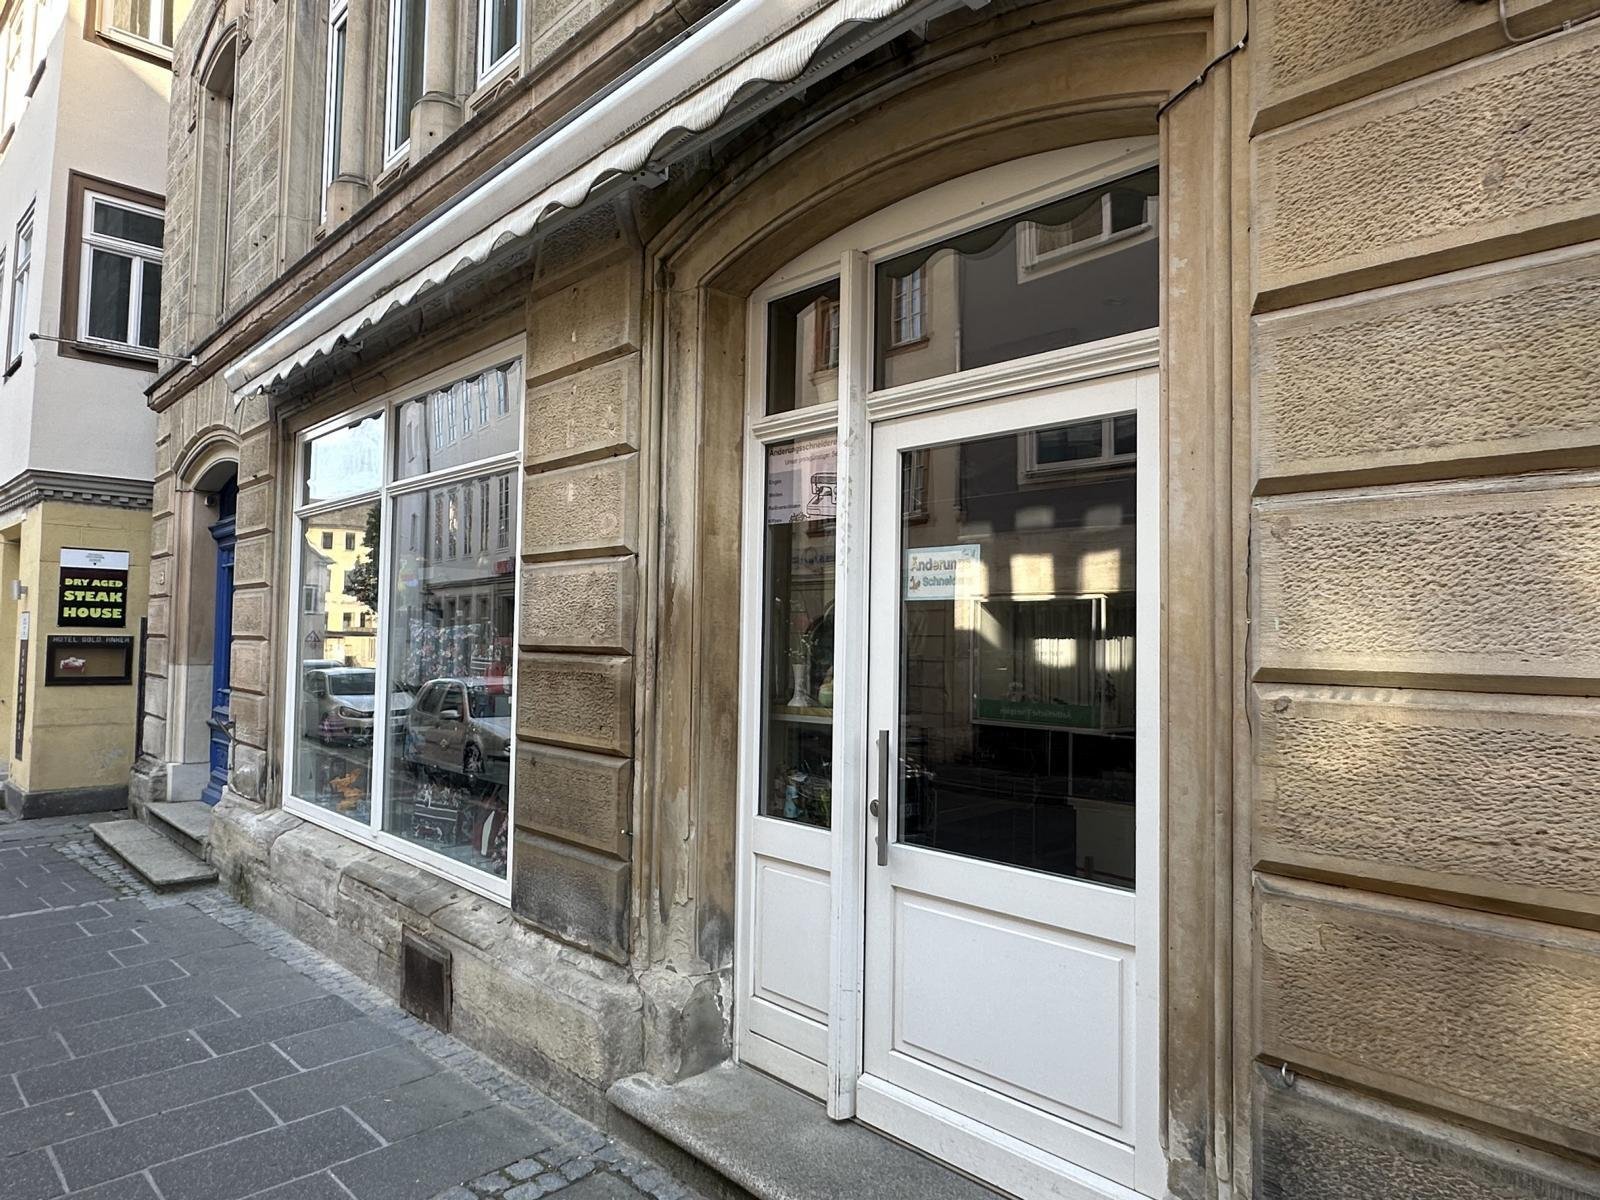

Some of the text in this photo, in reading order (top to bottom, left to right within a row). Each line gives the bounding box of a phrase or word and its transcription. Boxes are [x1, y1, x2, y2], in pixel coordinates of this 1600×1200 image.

[910, 556, 970, 572] Änderun
[65, 578, 124, 587] DRY AGED
[64, 590, 123, 603] STEAK
[63, 607, 122, 619] HOUSE
